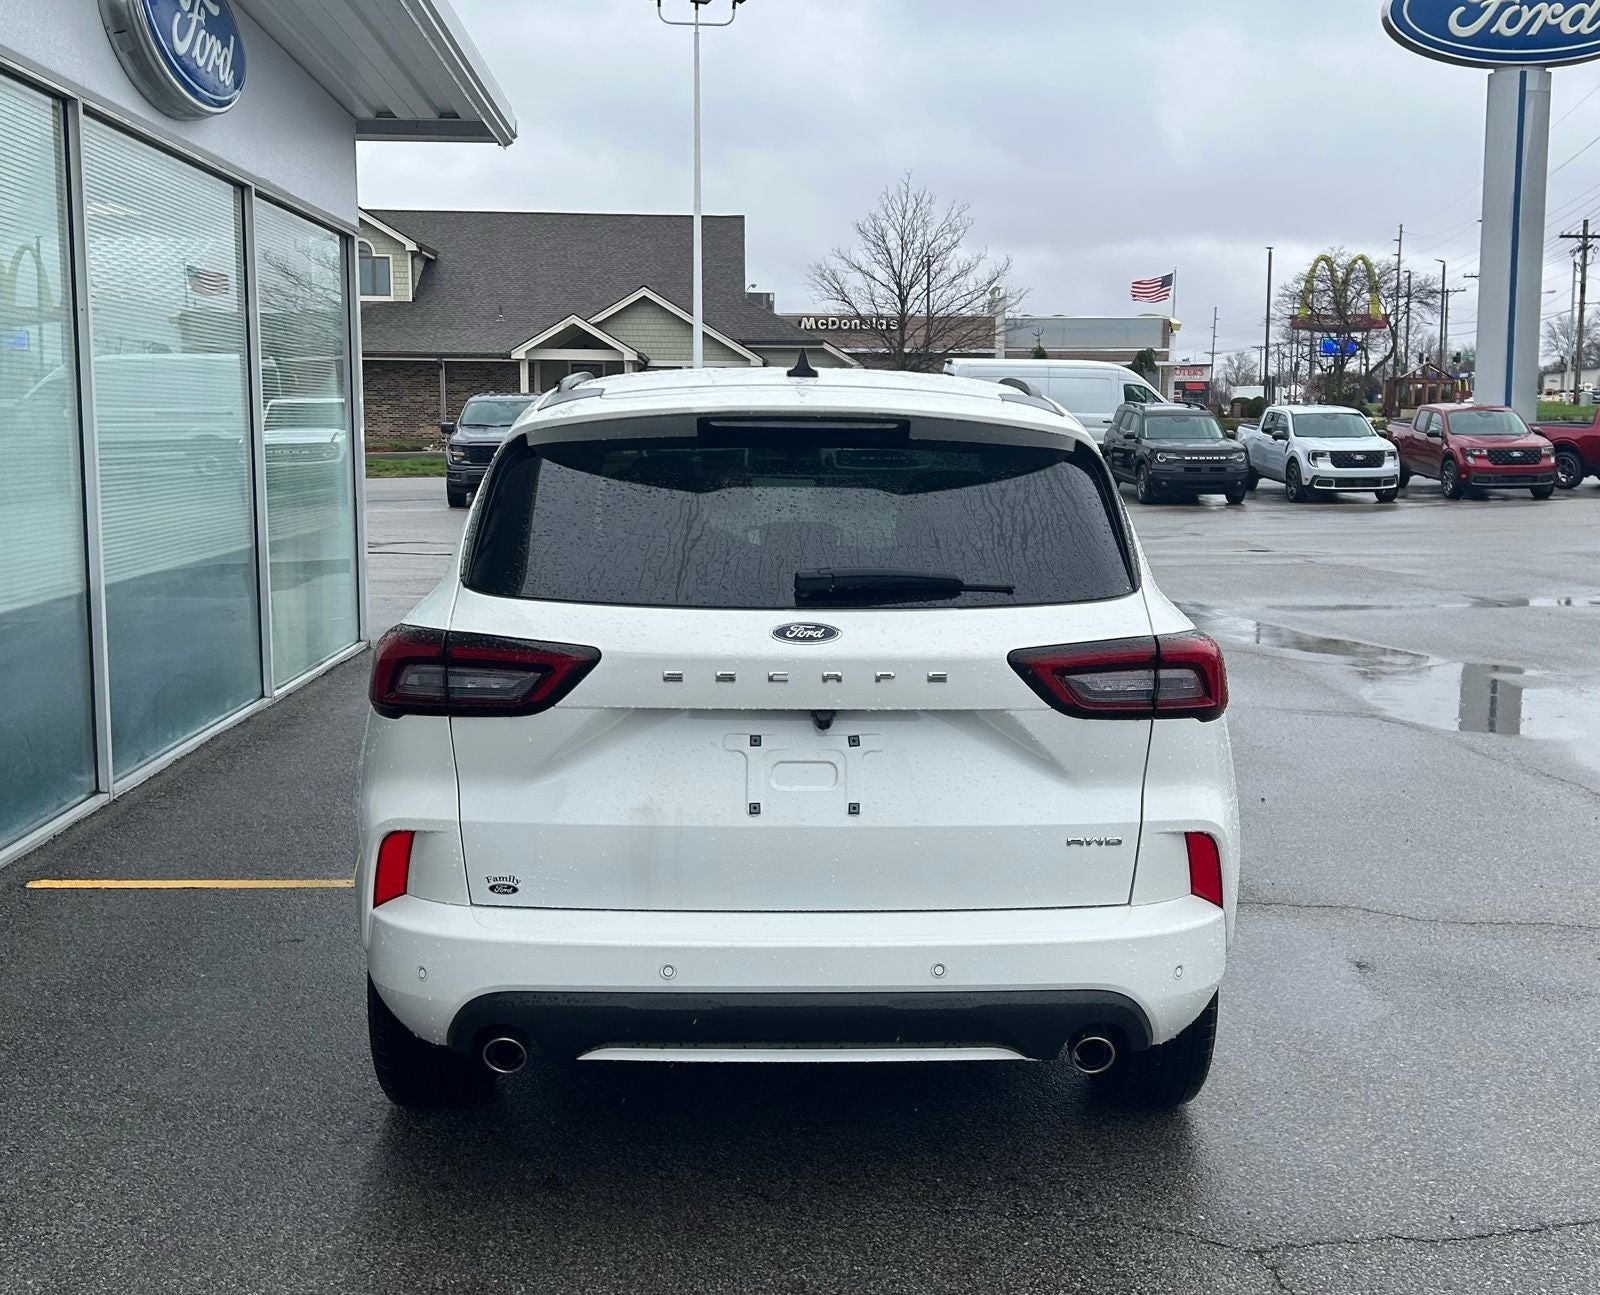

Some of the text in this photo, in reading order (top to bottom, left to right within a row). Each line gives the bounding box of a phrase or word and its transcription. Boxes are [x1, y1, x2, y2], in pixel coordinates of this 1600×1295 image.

[1448, 0, 1600, 38] Ford
[172, 0, 235, 87] Ford
[786, 625, 825, 638] Ford
[662, 671, 948, 683] ESCAPE
[1066, 837, 1123, 847] AWD
[485, 874, 522, 886] Family
[494, 885, 514, 894] Ford
